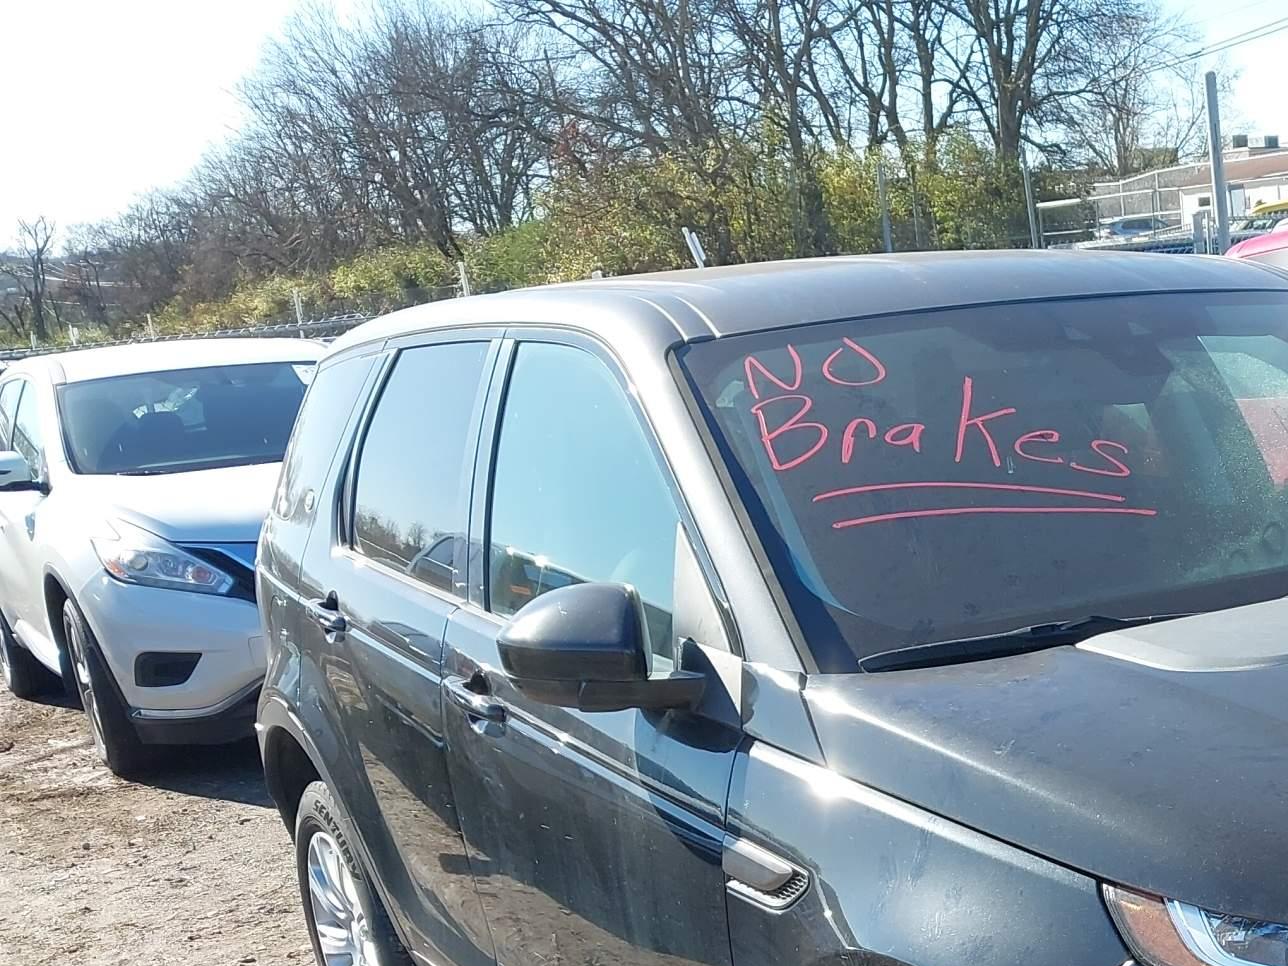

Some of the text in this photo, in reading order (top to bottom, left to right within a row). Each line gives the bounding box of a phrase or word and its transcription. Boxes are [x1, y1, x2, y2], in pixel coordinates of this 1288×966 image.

[743, 337, 887, 399] NO
[749, 375, 1131, 478] Brakes
[312, 799, 362, 881] SENTURY
